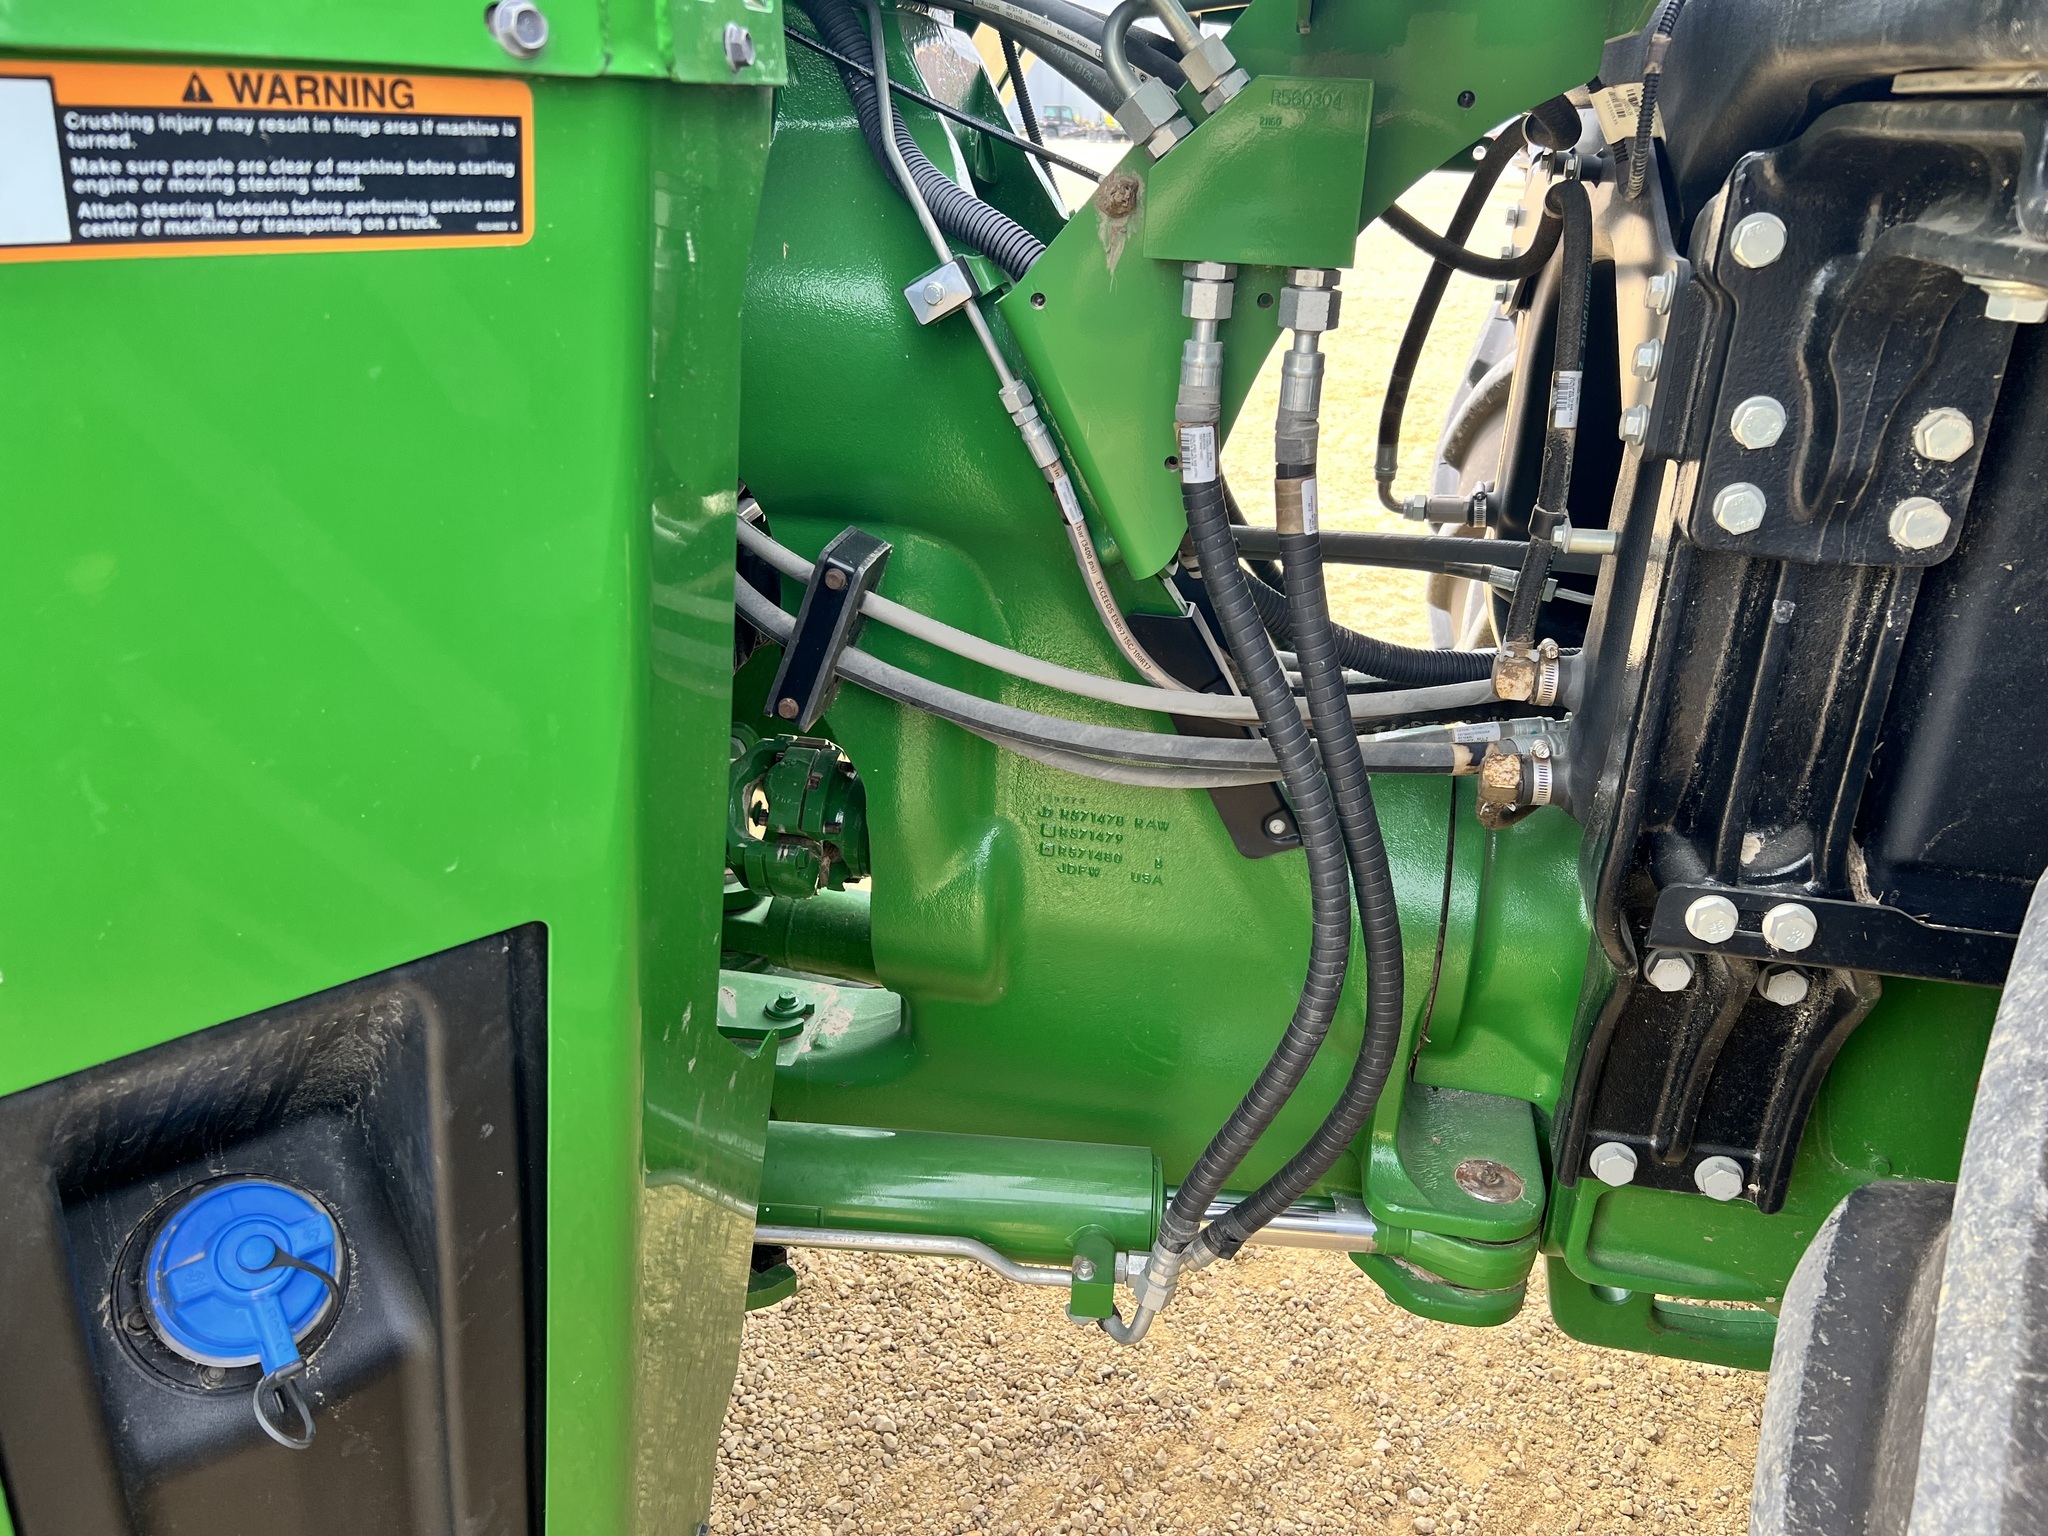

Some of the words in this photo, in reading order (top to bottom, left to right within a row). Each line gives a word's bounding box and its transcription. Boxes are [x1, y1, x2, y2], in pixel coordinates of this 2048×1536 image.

[1051, 46, 1065, 58] 215
[1064, 54, 1075, 67] bar
[1074, 60, 1093, 80] (3125
[226, 71, 415, 109] WARNING
[64, 110, 155, 135] Crushing
[158, 112, 213, 135] injury
[216, 115, 255, 136] may
[258, 114, 310, 134] result
[312, 115, 331, 134] in
[333, 116, 380, 138] hinge
[382, 120, 419, 136] area
[421, 117, 434, 136] if
[436, 118, 499, 137] machine
[502, 121, 517, 138] is
[66, 131, 138, 150] turned.
[70, 156, 123, 176] Make
[125, 159, 169, 176] sure
[171, 156, 235, 179] people
[237, 158, 267, 176] are
[269, 156, 312, 176] clear
[314, 157, 334, 176] of
[336, 157, 404, 176] machine
[406, 158, 456, 176] before
[458, 159, 515, 178] starting
[72, 176, 139, 197] engine
[142, 178, 164, 194] or
[167, 176, 235, 196] moving
[237, 175, 310, 196] steering
[311, 175, 365, 192] wheel.
[77, 200, 138, 220] Attach
[141, 200, 214, 220] steering
[216, 198, 290, 217] lockouts
[291, 198, 343, 216] before
[345, 197, 428, 217] performing
[430, 198, 482, 214] service
[484, 199, 515, 213] near
[79, 219, 138, 238] center
[141, 217, 161, 237] of
[163, 217, 238, 236] machine
[240, 219, 260, 234] or
[262, 215, 361, 235] transporting
[362, 217, 385, 231] on
[387, 218, 397, 231] a
[399, 214, 442, 231] truck.
[1076, 524, 1085, 539] bar
[1081, 538, 1092, 560] (3400
[1088, 560, 1098, 574] psi)
[1096, 581, 1114, 615] EXCEEDS
[1111, 613, 1125, 636] EN857
[1059, 826, 1124, 844] R571479
[1134, 817, 1170, 832] RAW
[1057, 862, 1100, 878] JDFW
[1130, 871, 1164, 885] USA
